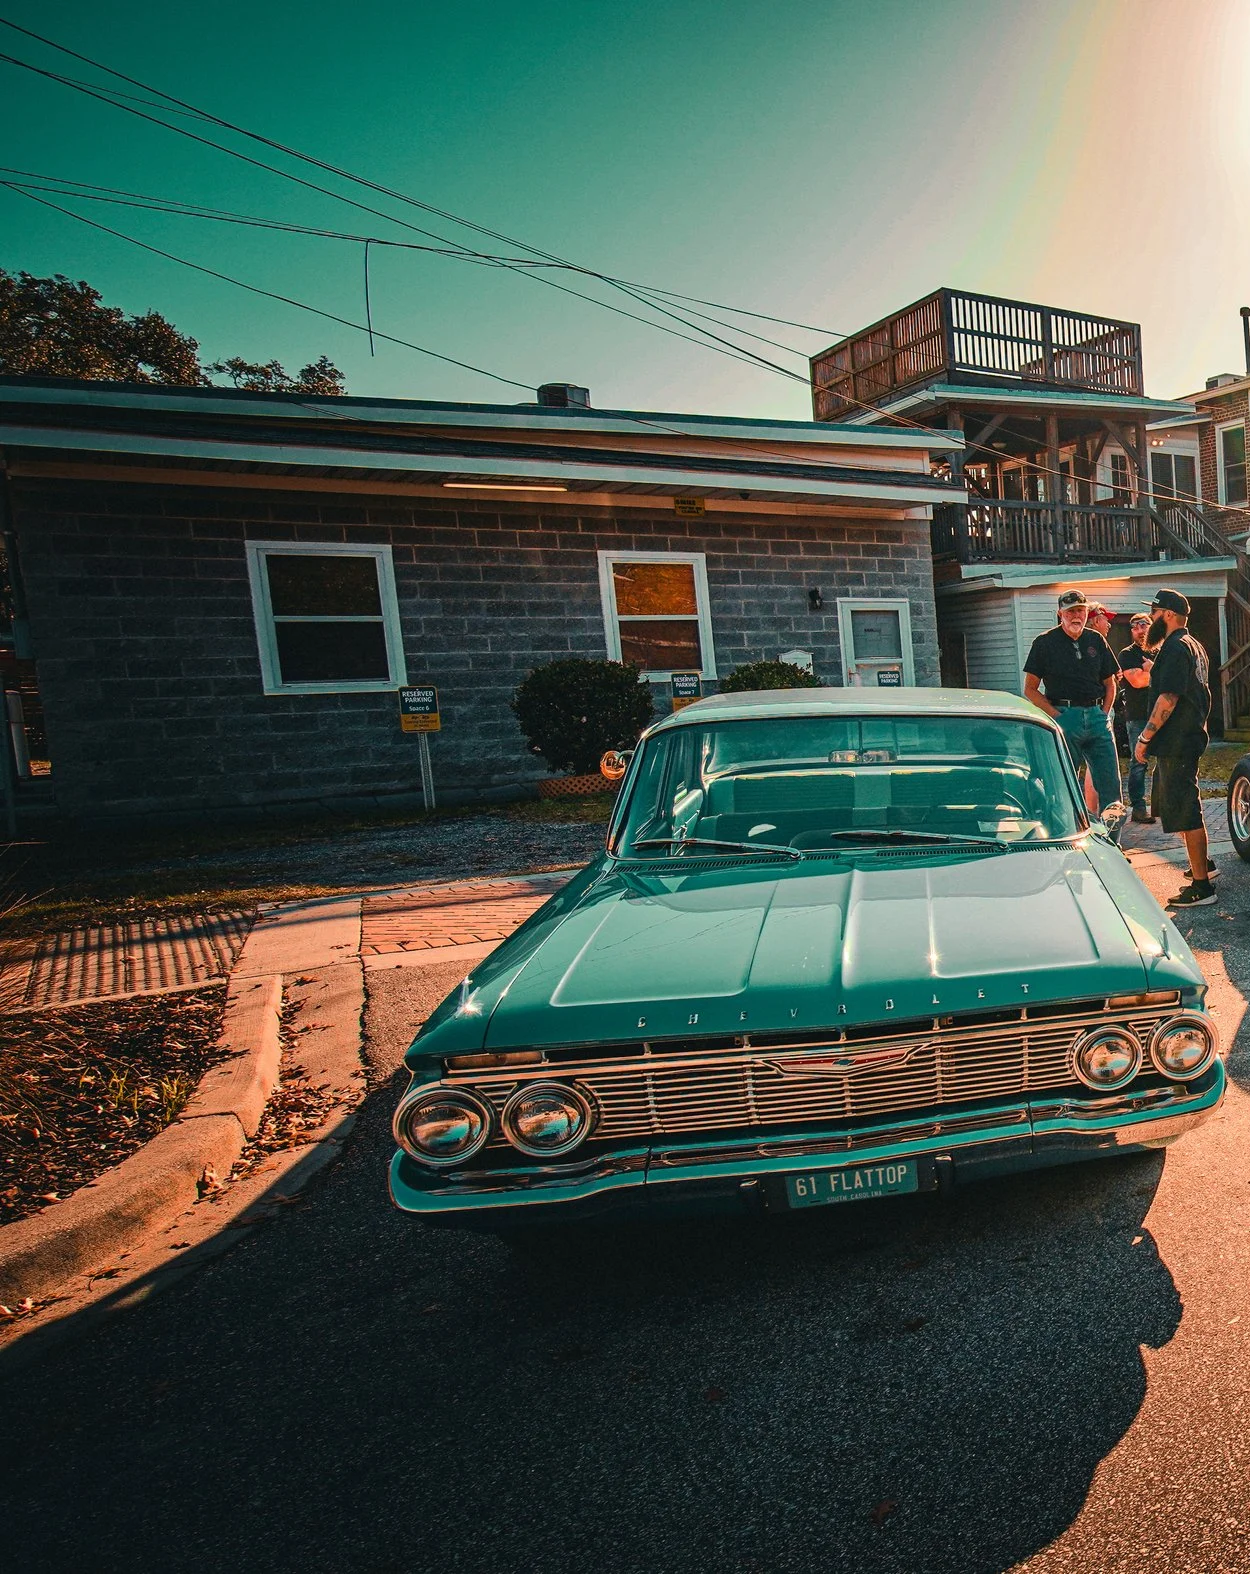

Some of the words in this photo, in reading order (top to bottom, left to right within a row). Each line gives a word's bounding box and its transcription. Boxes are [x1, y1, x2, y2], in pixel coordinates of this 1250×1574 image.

[637, 983, 1030, 1028] CHEVROLET
[795, 1176, 817, 1196] 61
[830, 1165, 907, 1192] FLATTOP
[850, 1190, 883, 1201] CAROLINA
